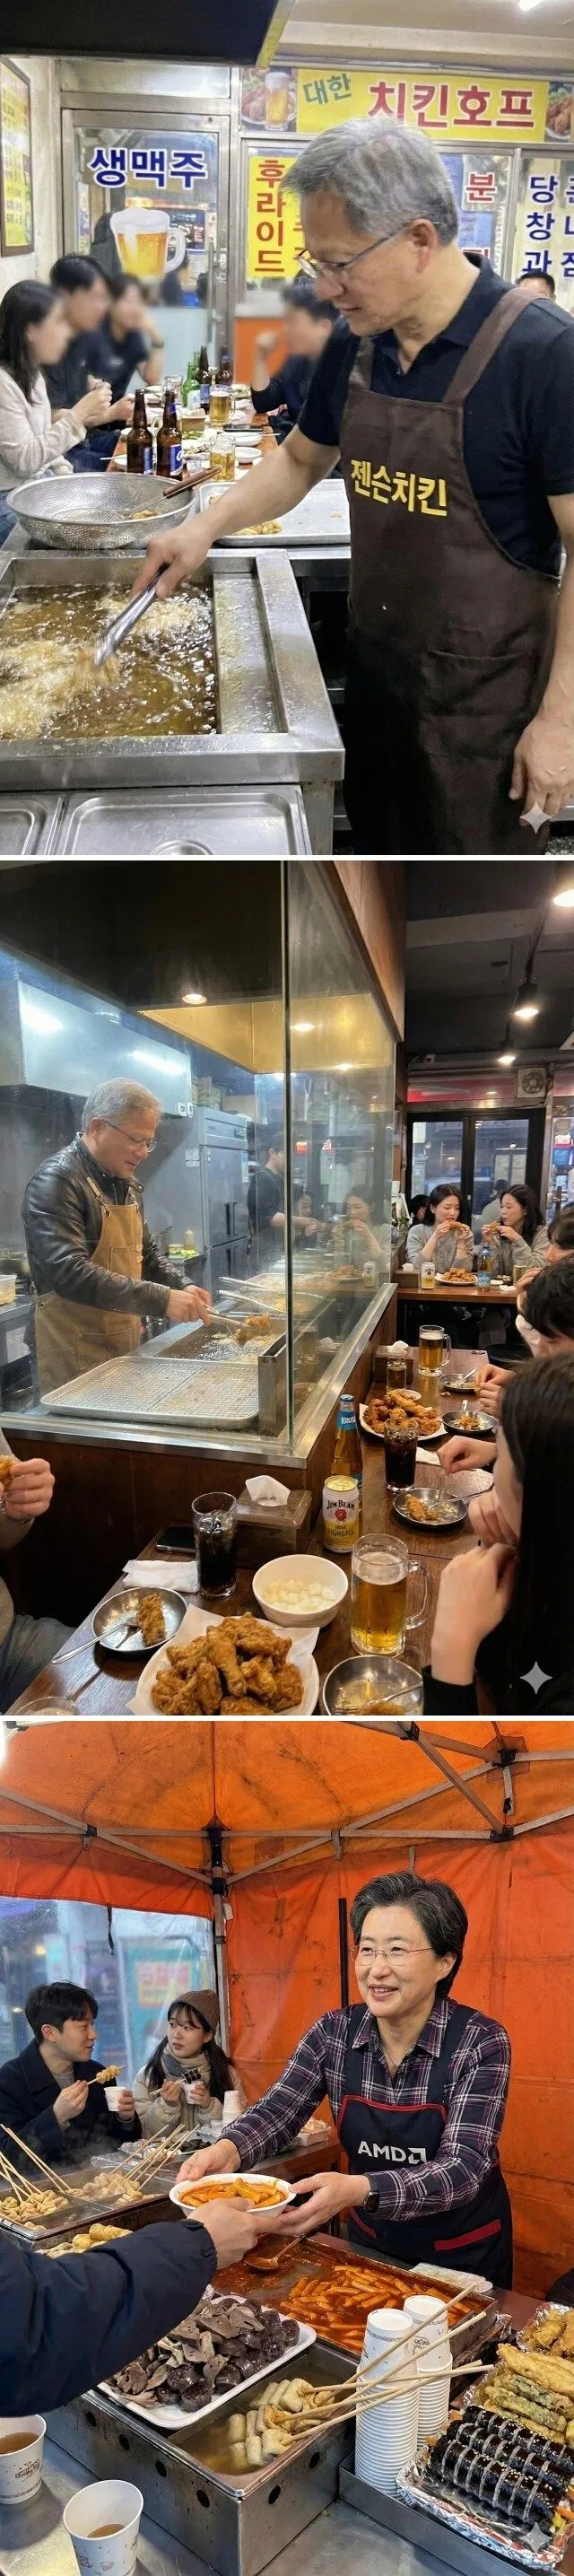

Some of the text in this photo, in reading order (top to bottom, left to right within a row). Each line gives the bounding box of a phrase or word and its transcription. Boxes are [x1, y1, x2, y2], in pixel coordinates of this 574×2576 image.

[302, 74, 535, 129] 대한 치킨호프
[89, 148, 208, 188] 생맥주
[255, 160, 286, 272] 후라이드
[350, 458, 448, 517] 젠슨치킨
[341, 1416, 356, 1425] KRUS
[357, 2140, 407, 2162] AMD
